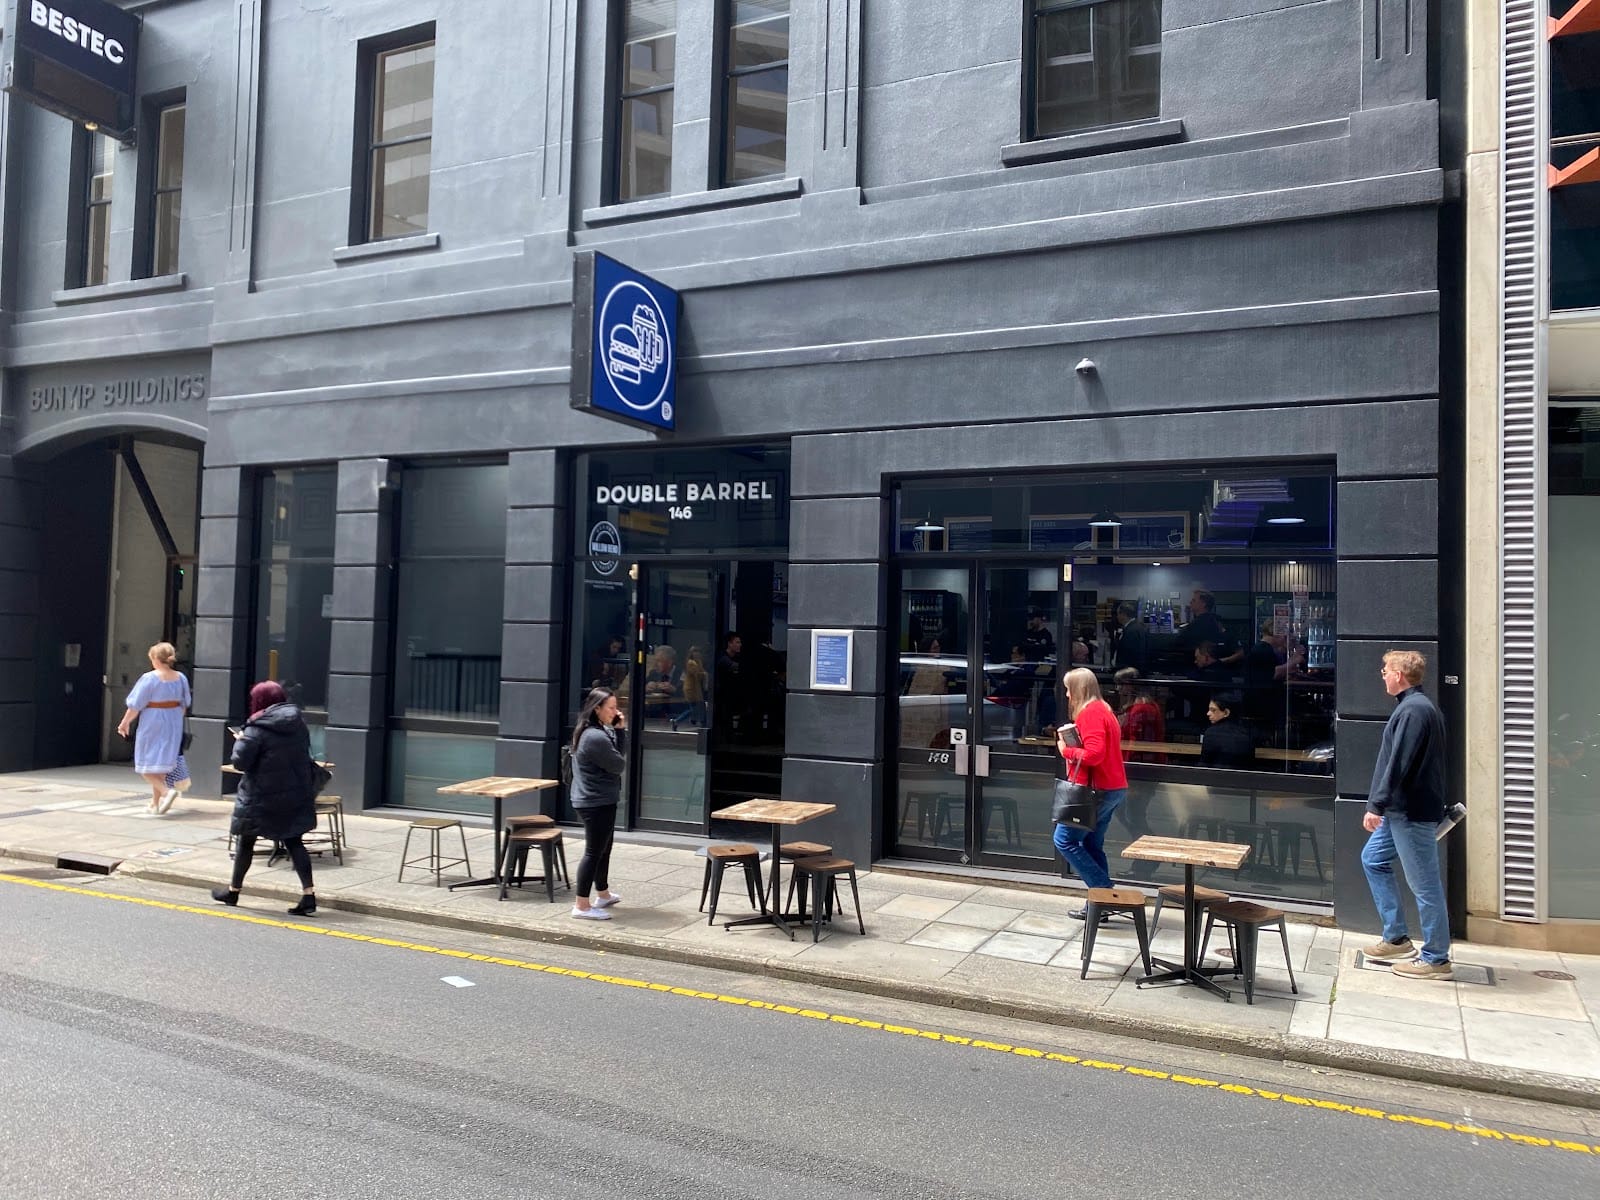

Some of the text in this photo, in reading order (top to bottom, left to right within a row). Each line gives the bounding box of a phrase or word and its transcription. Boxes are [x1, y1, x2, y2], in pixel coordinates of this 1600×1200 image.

[30, 0, 124, 64] BESTEC
[30, 374, 207, 412] BUNYIP BUILDINGS
[597, 481, 772, 503] DOUBLE BARREL
[668, 505, 693, 520] 146
